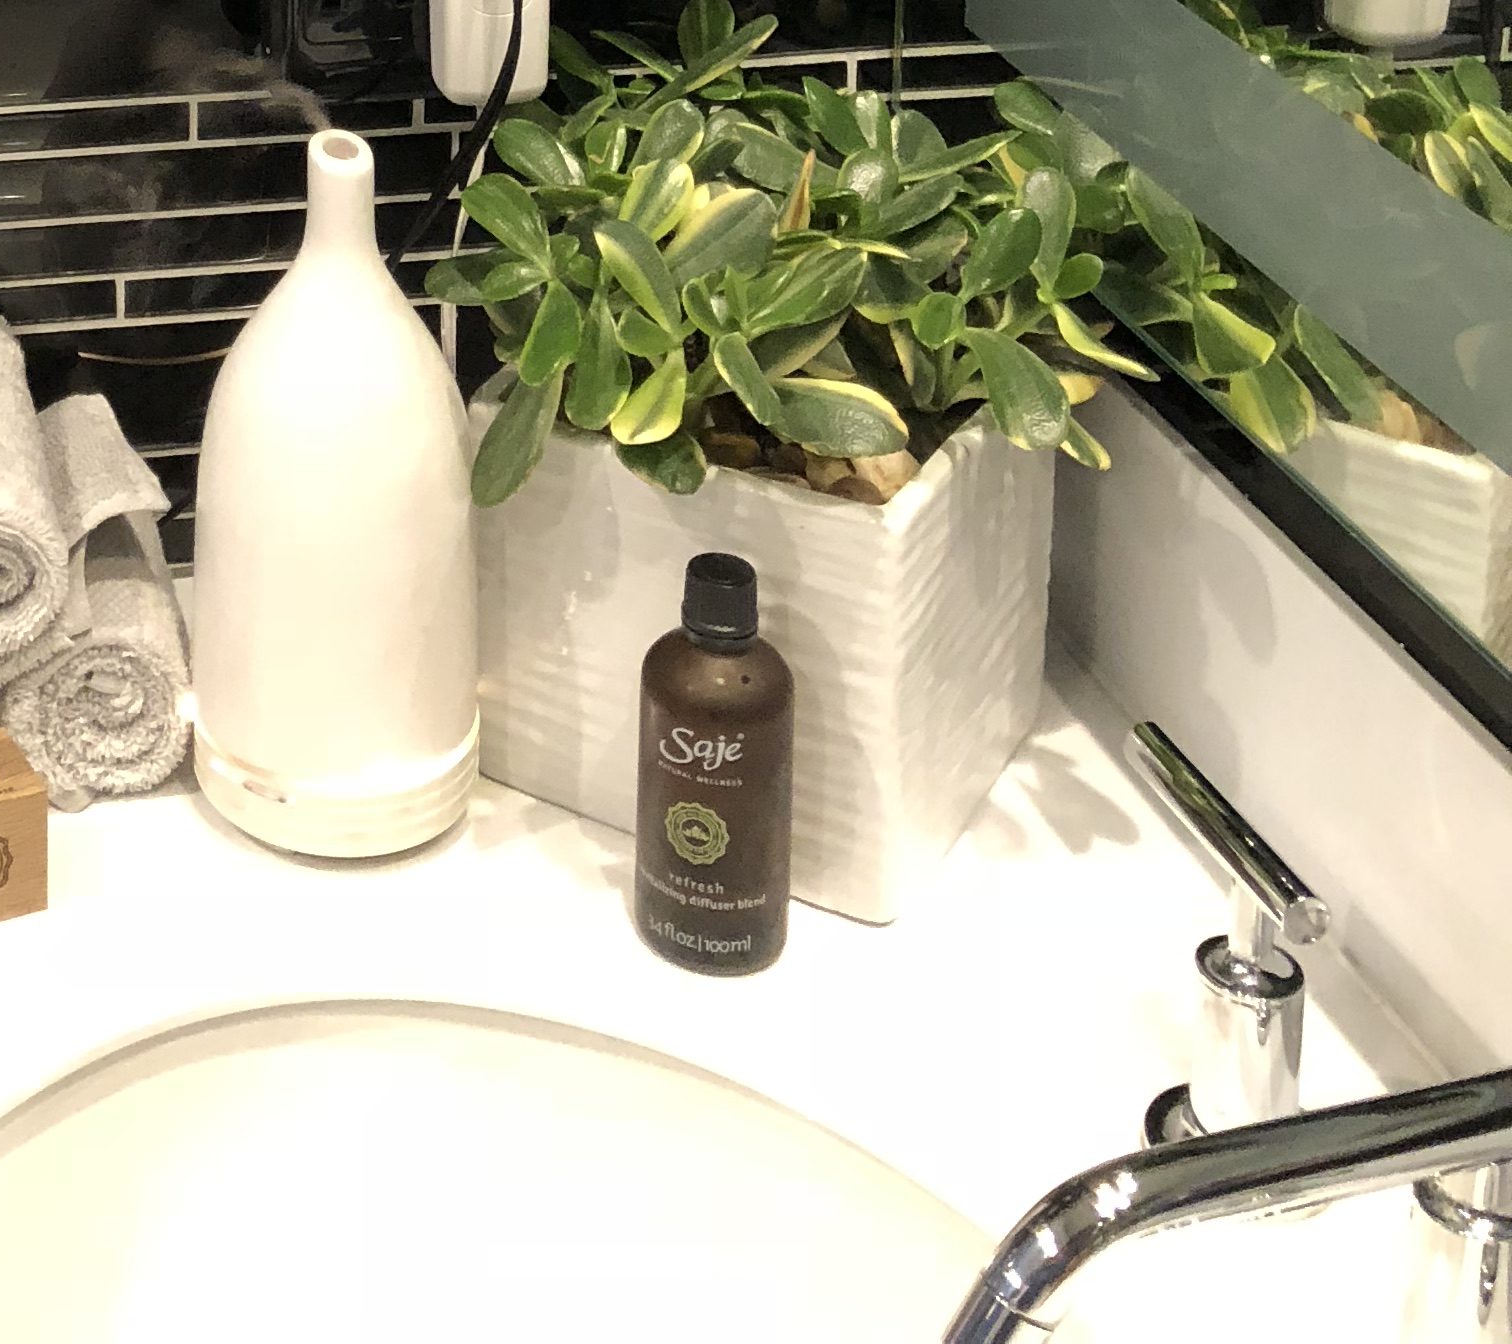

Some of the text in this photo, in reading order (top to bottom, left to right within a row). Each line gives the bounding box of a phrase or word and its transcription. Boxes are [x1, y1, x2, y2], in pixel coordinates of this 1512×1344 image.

[668, 872, 724, 894] refresh
[689, 894, 735, 911] diffuser
[738, 893, 767, 910] blend
